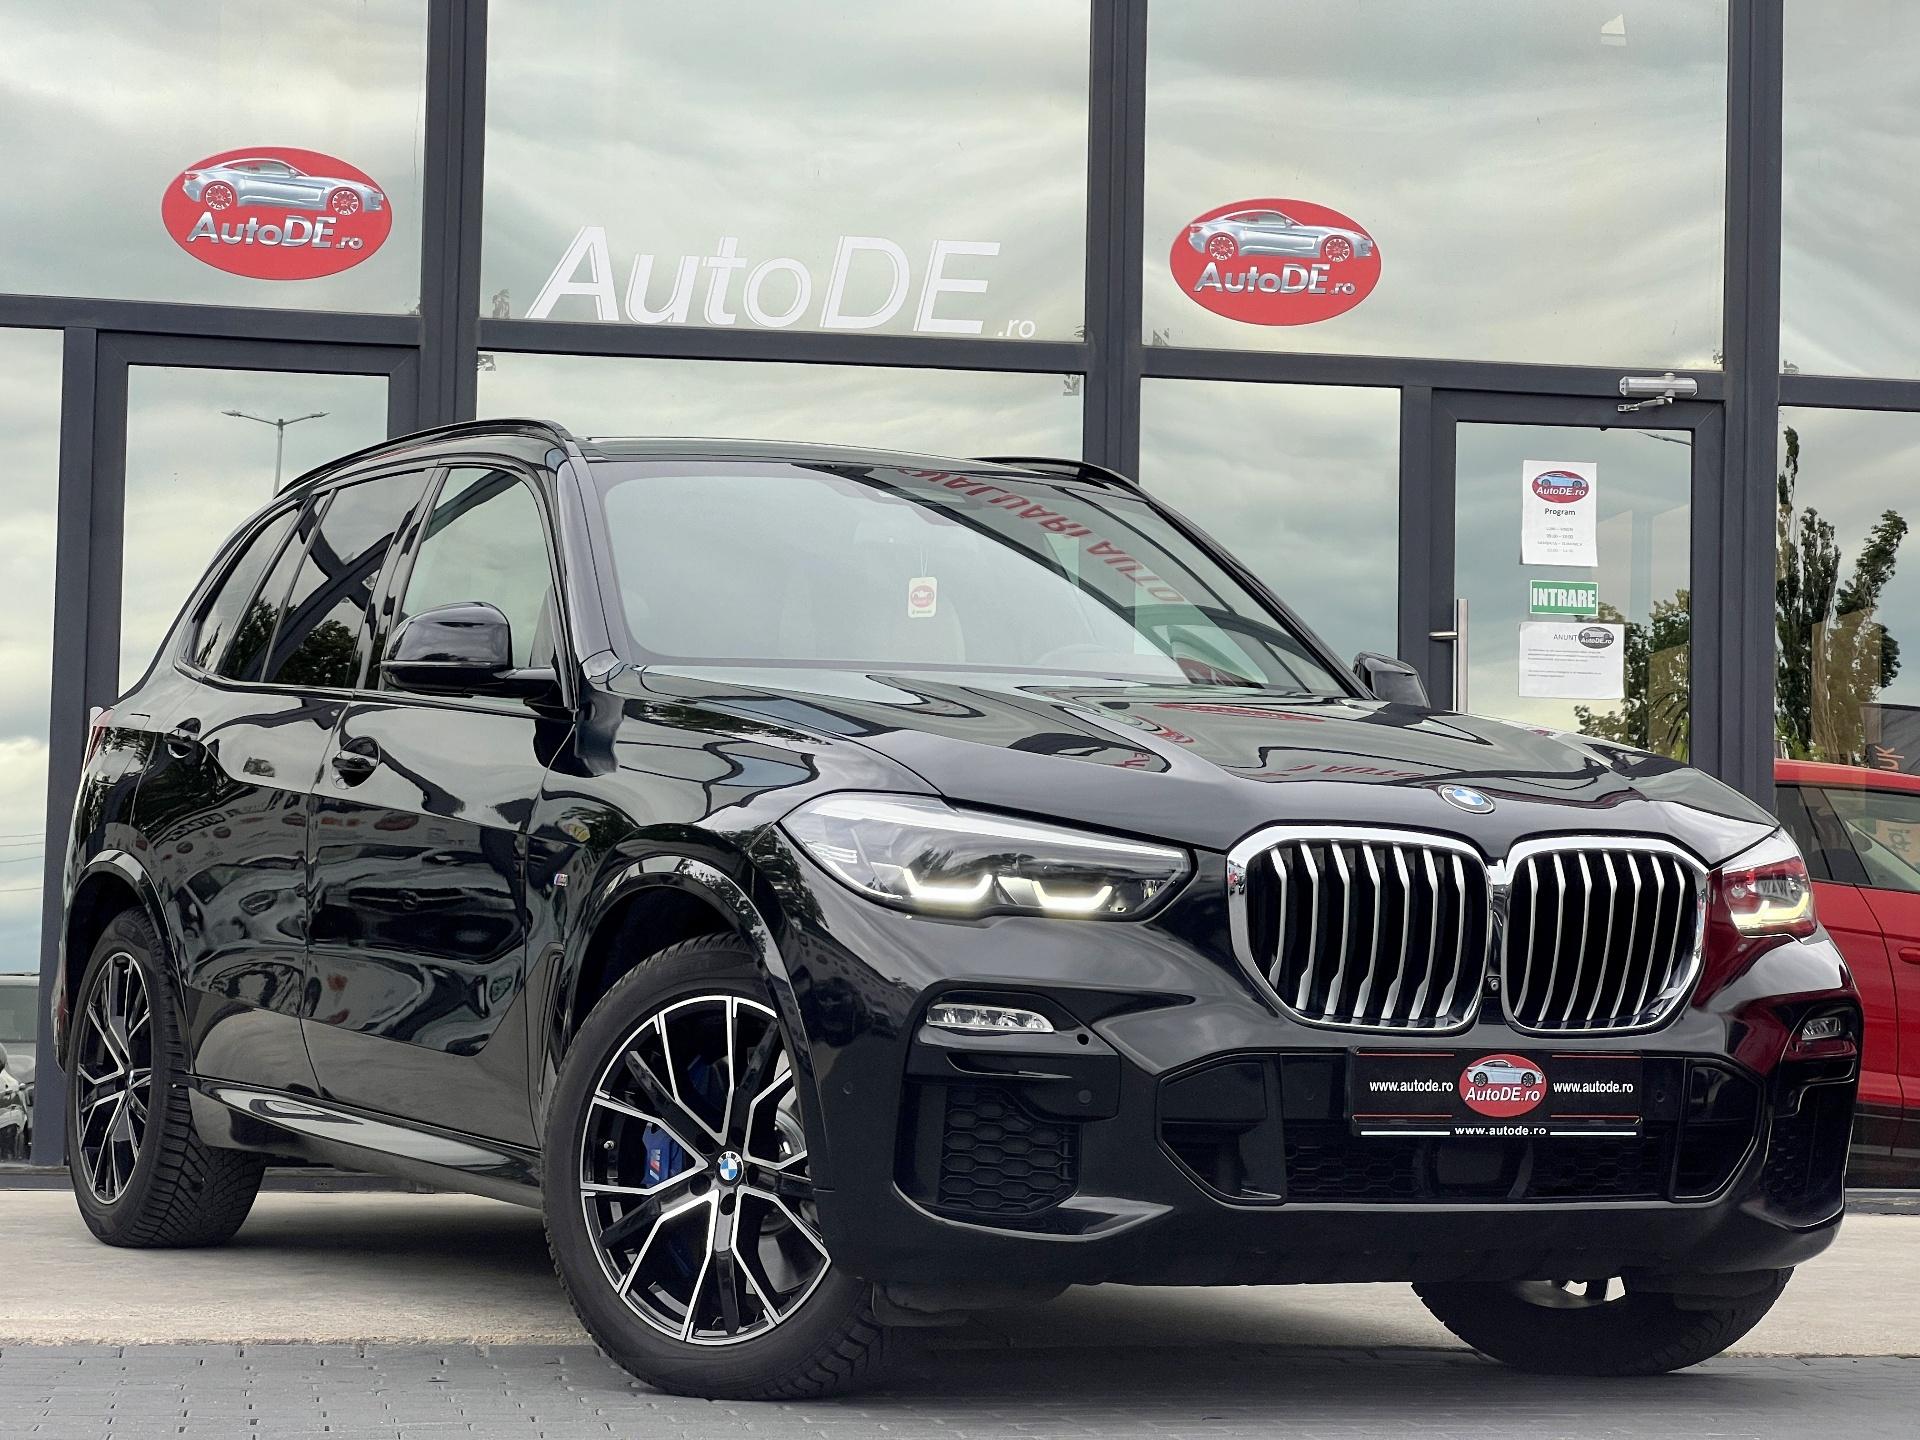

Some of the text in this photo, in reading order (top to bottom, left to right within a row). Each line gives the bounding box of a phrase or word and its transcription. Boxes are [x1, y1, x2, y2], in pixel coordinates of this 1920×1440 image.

[1544, 507, 1576, 516] Program
[1532, 587, 1596, 608] INTRARE
[1369, 1079, 1454, 1093] www.autode.ro
[1552, 1080, 1634, 1094] www.autode.ro
[1464, 1086, 1541, 1102] AutoDE.ro
[1454, 1125, 1547, 1136] www.autode.ro
